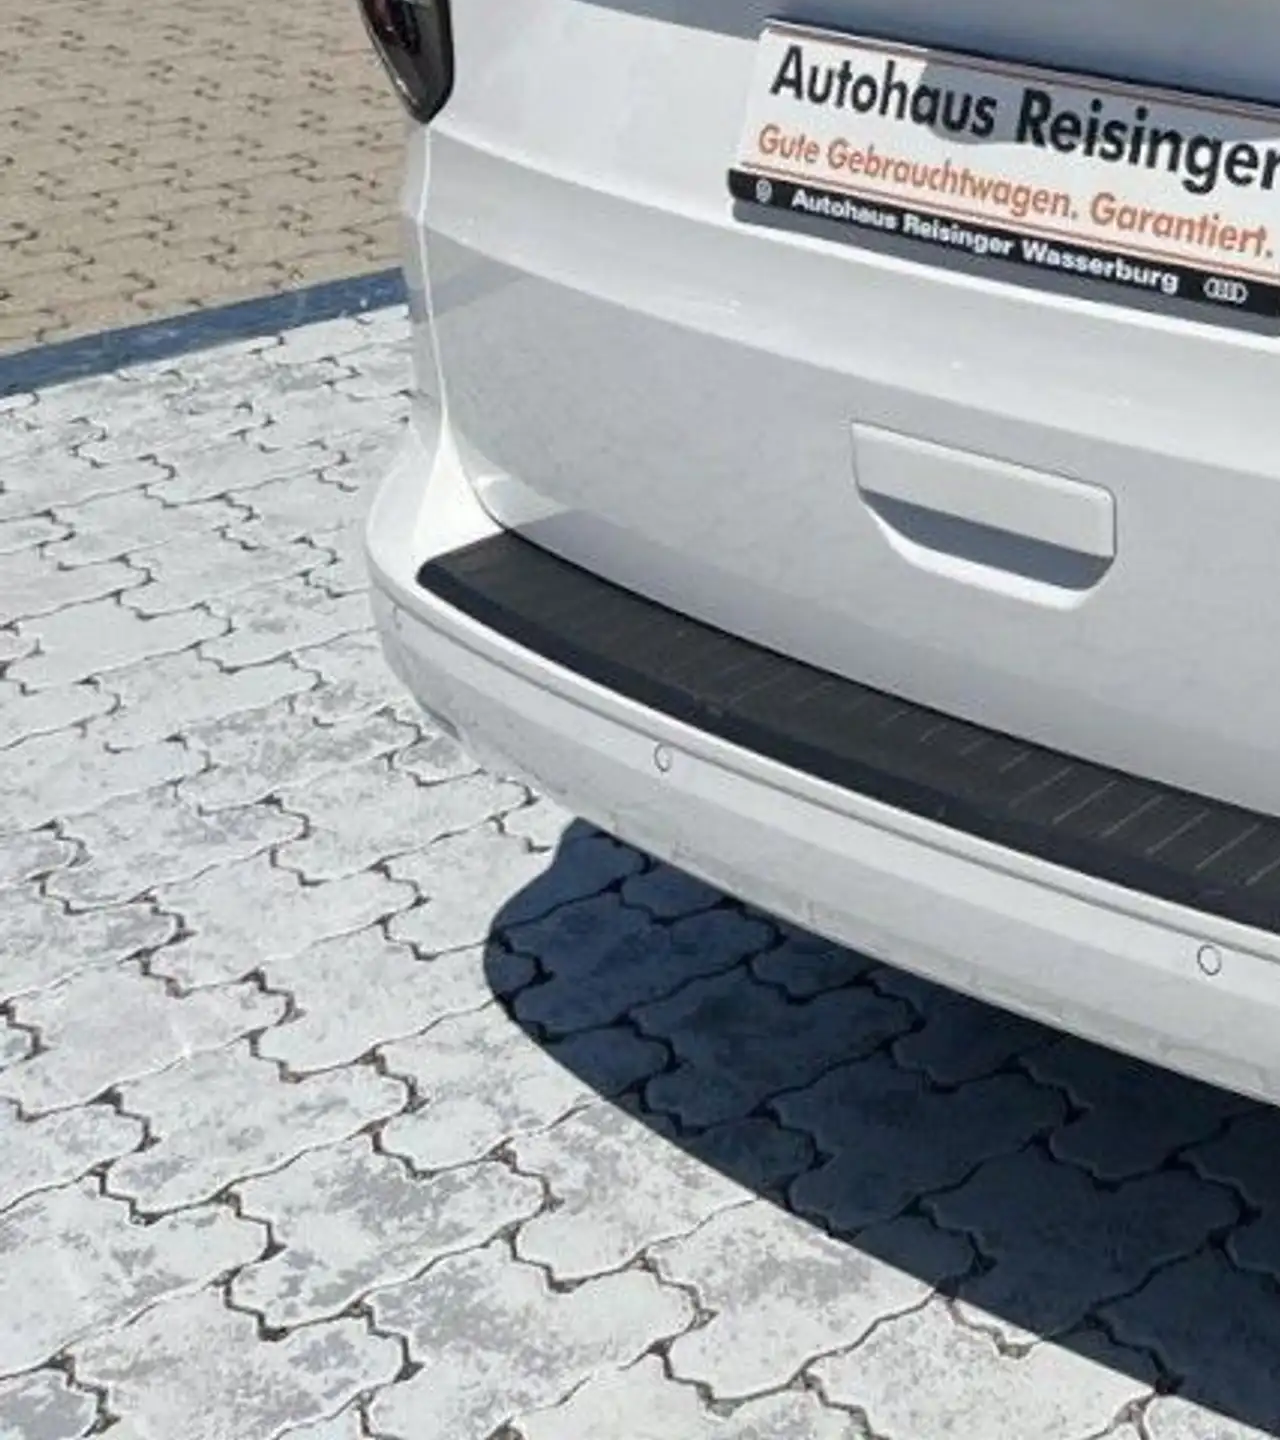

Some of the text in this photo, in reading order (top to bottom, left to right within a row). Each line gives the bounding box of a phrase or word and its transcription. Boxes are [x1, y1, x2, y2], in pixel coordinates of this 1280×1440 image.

[769, 45, 998, 138] Autohaus
[758, 123, 1274, 259] Gute Gebrauchtwagen. Garantiert.
[791, 189, 1181, 295] Autohaus Reisinger Wasserburg
